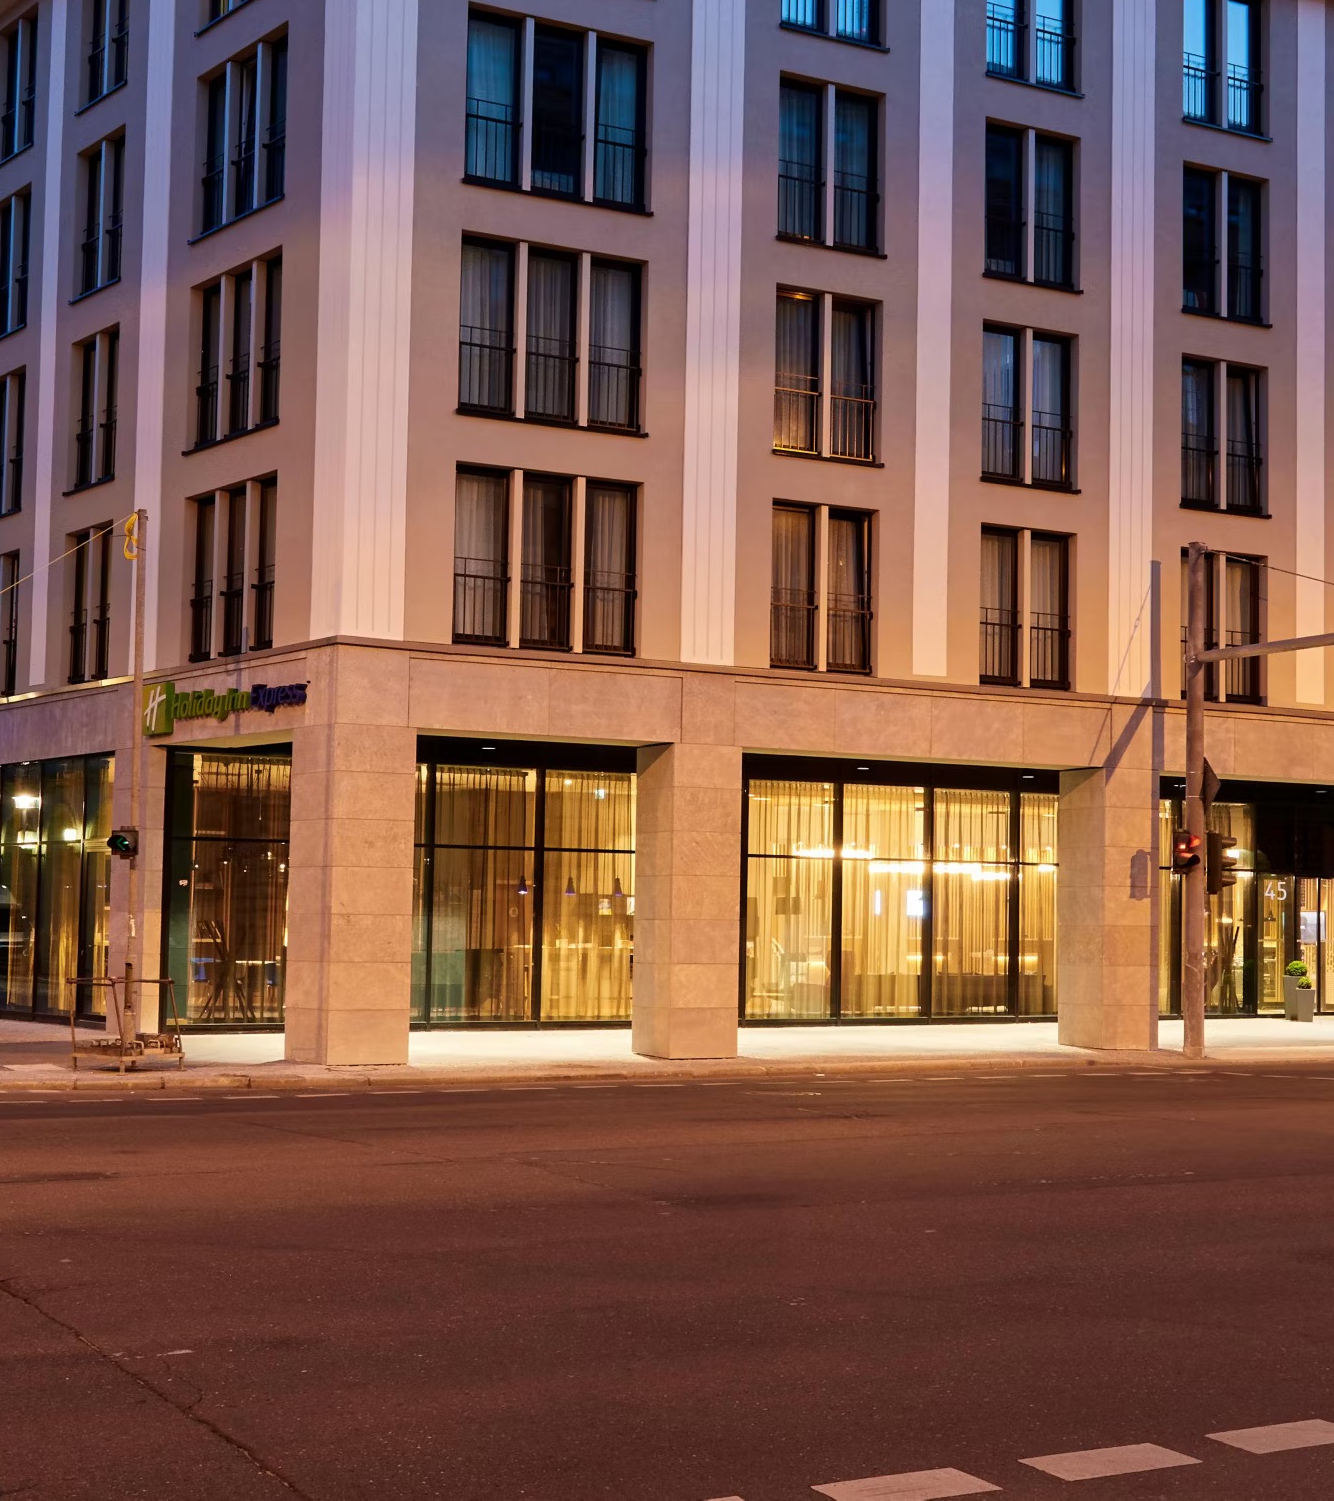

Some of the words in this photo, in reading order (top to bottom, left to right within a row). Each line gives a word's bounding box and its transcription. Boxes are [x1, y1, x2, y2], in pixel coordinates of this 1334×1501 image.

[171, 690, 225, 721] Holiday
[224, 688, 250, 712] Inn
[251, 684, 307, 712] Express
[1264, 881, 1288, 901] 45
